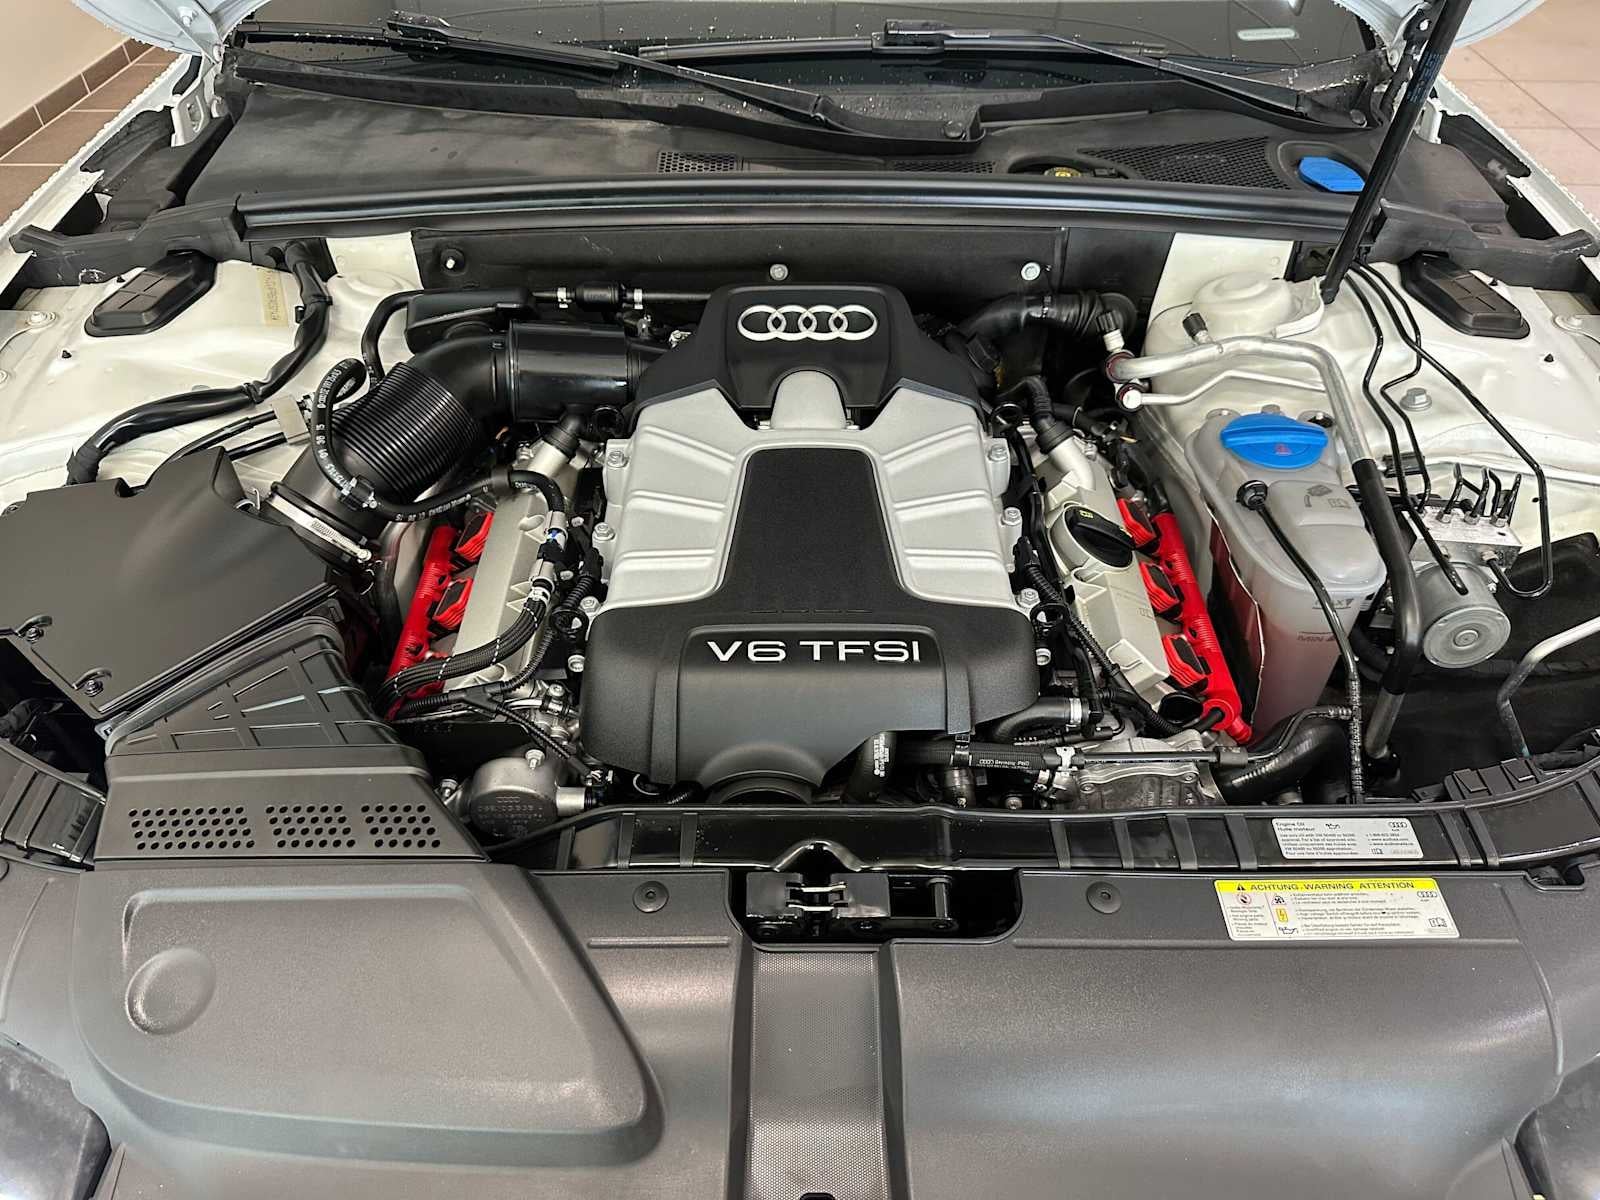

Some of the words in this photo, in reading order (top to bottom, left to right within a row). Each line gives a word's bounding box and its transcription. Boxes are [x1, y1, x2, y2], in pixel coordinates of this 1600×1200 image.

[707, 640, 787, 662] V6
[799, 640, 921, 662] TFSI
[1250, 883, 1299, 891] ACHTUNG
[1303, 882, 1354, 890] WARNING
[1359, 881, 1415, 889] ATTENTION
